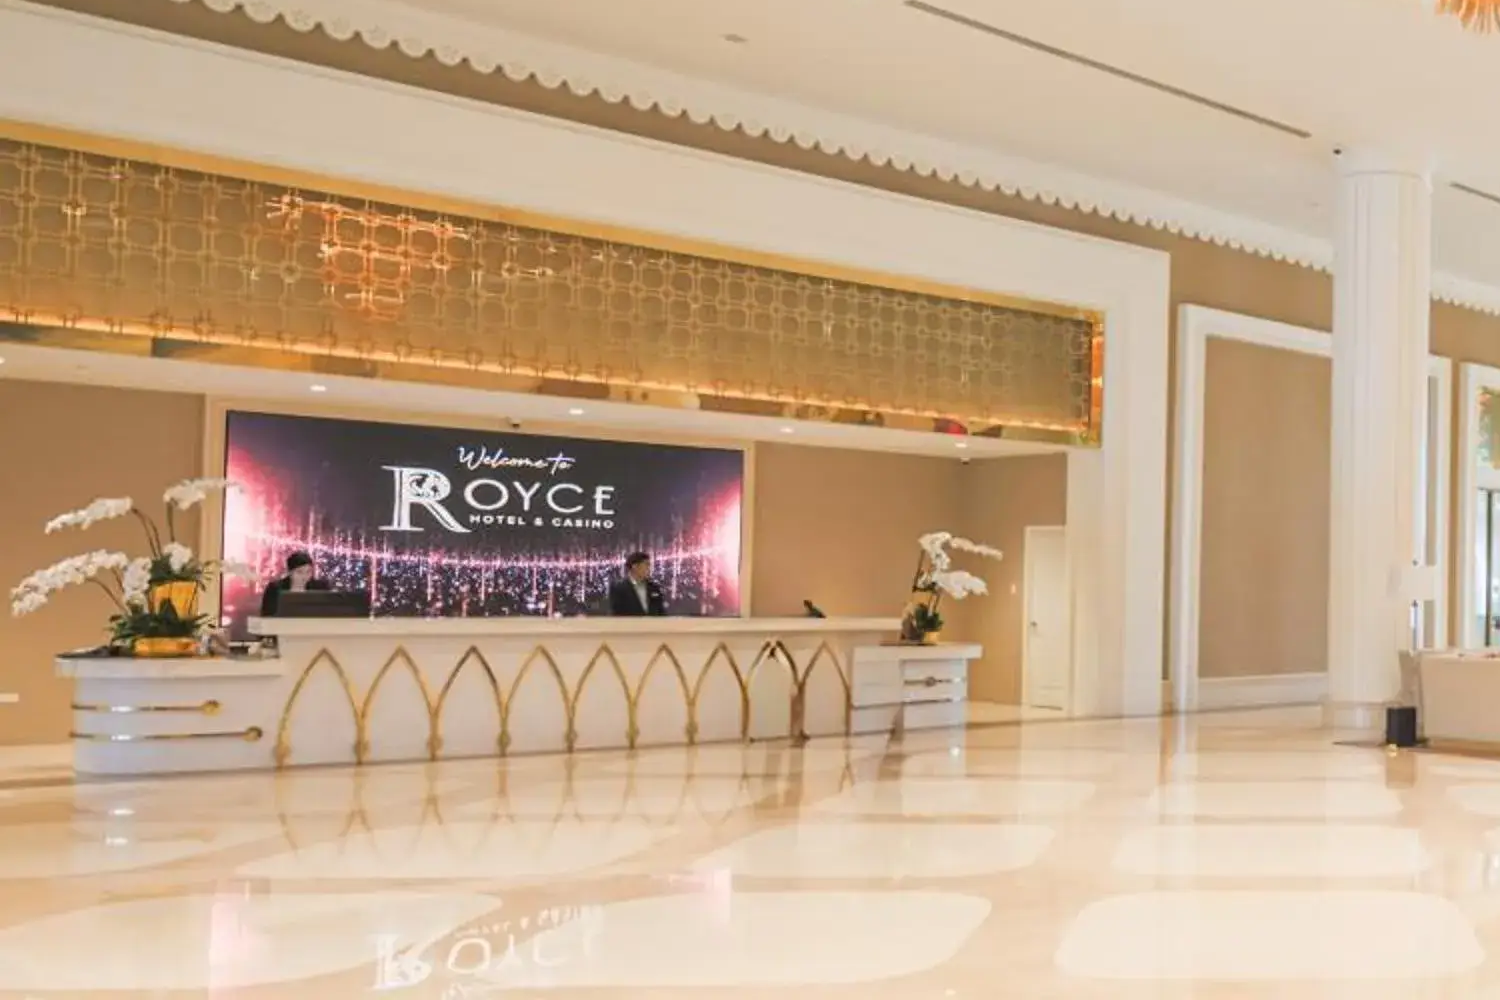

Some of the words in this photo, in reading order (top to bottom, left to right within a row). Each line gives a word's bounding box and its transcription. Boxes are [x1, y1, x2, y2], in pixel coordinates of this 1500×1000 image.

[458, 446, 547, 471] Welcome
[547, 453, 576, 475] to
[378, 465, 615, 533] ROYCE
[469, 514, 526, 526] HOTEL
[534, 516, 544, 527] &
[551, 517, 615, 529] CASINO
